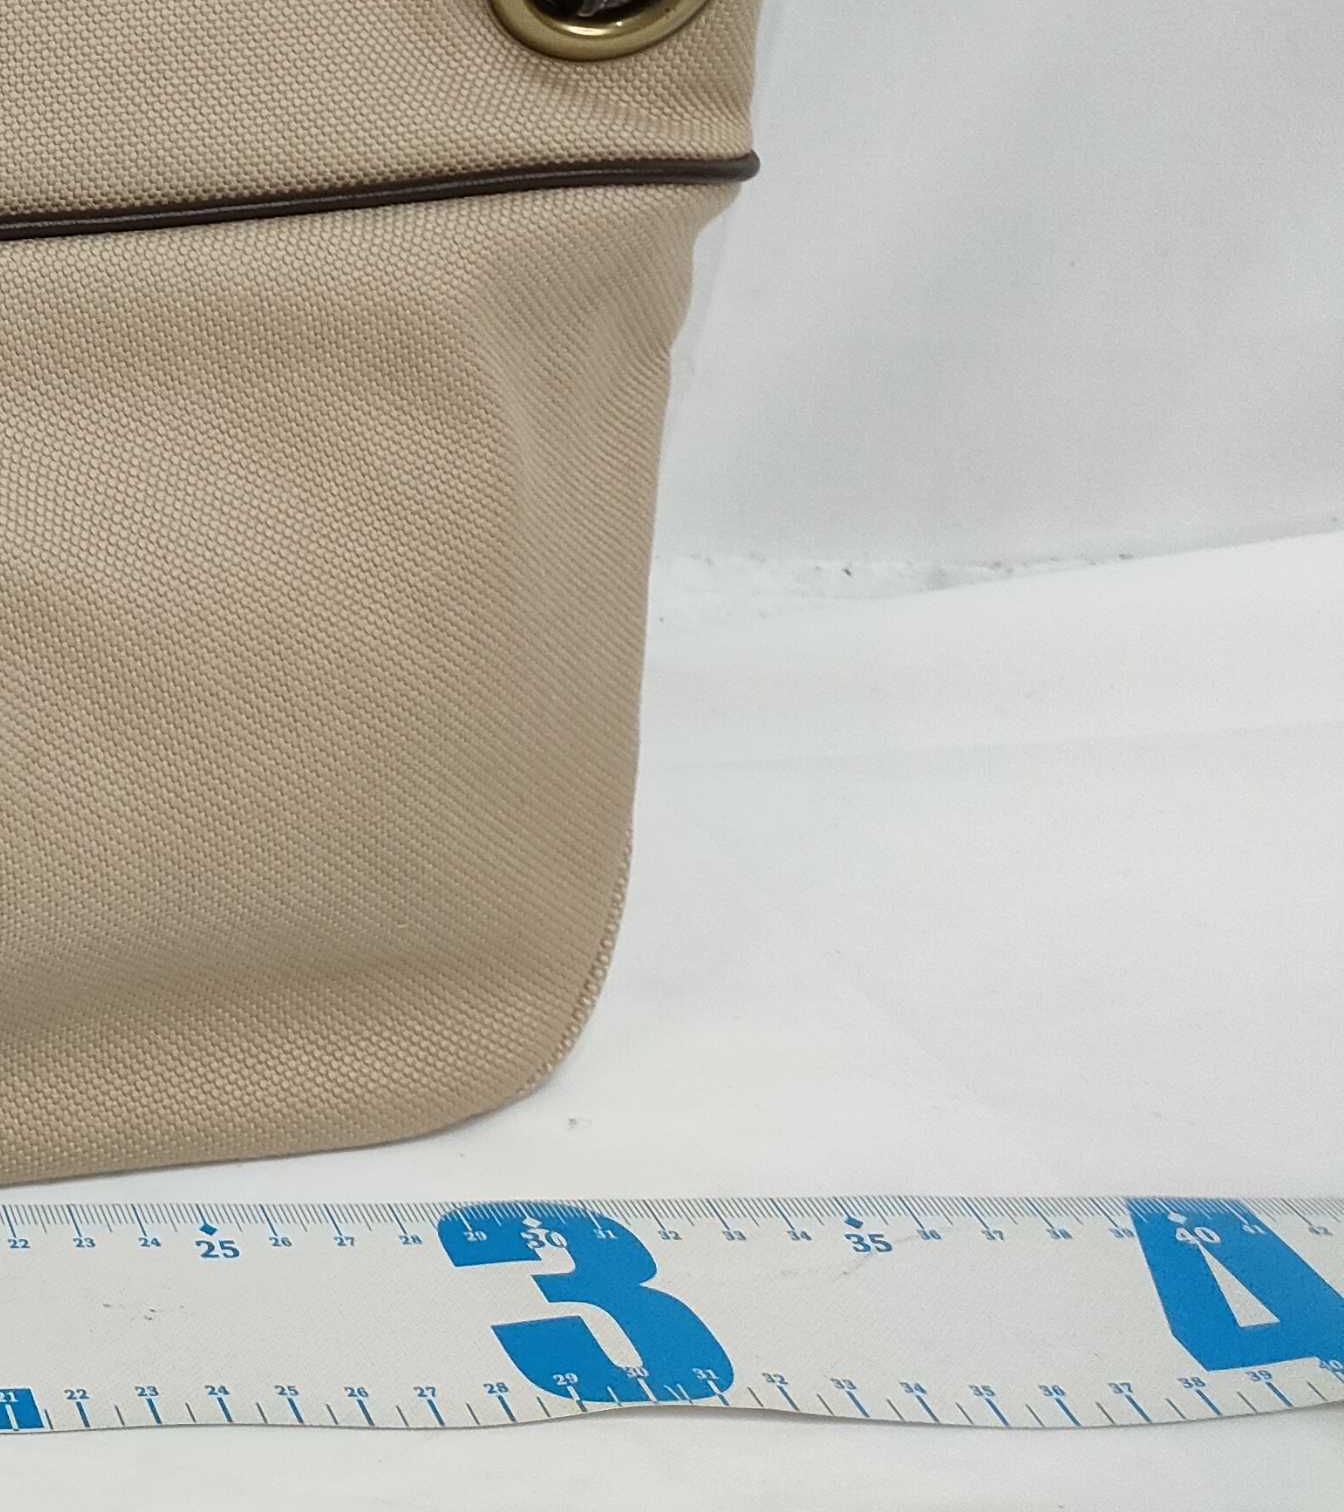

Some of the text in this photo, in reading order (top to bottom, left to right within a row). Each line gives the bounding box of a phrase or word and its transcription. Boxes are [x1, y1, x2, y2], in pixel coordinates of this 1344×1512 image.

[8, 1239, 30, 1248] 22
[73, 1238, 96, 1248] 23
[139, 1238, 161, 1247] 24
[196, 1240, 240, 1258] 25
[270, 1237, 292, 1247] 26
[334, 1236, 355, 1246] 27
[400, 1235, 422, 1245] 28
[464, 1231, 487, 1242] 29
[521, 1229, 568, 1249] 30
[594, 1229, 616, 1240] 31
[659, 1230, 681, 1240] 32
[723, 1230, 746, 1241] 33
[788, 1230, 812, 1241] 34
[846, 1234, 892, 1254] 35
[1176, 1227, 1221, 1245] 40
[436, 1202, 735, 1404] 3
[1124, 1198, 1344, 1372] 4
[65, 1389, 89, 1400] 22
[135, 1385, 159, 1397] 23
[205, 1384, 230, 1396] 24
[275, 1385, 299, 1397] 25
[344, 1386, 369, 1398] 26
[414, 1386, 438, 1398] 27
[484, 1382, 508, 1395] 28
[553, 1373, 578, 1385] 29
[626, 1367, 648, 1379] 30
[694, 1368, 719, 1381] 31
[763, 1372, 788, 1385] 32
[832, 1378, 858, 1391] 33
[901, 1382, 927, 1395] 34
[970, 1384, 996, 1397] 35
[1040, 1384, 1065, 1397] 36
[1109, 1383, 1134, 1395] 37
[1178, 1377, 1206, 1389] 38
[1248, 1370, 1272, 1382] 39
